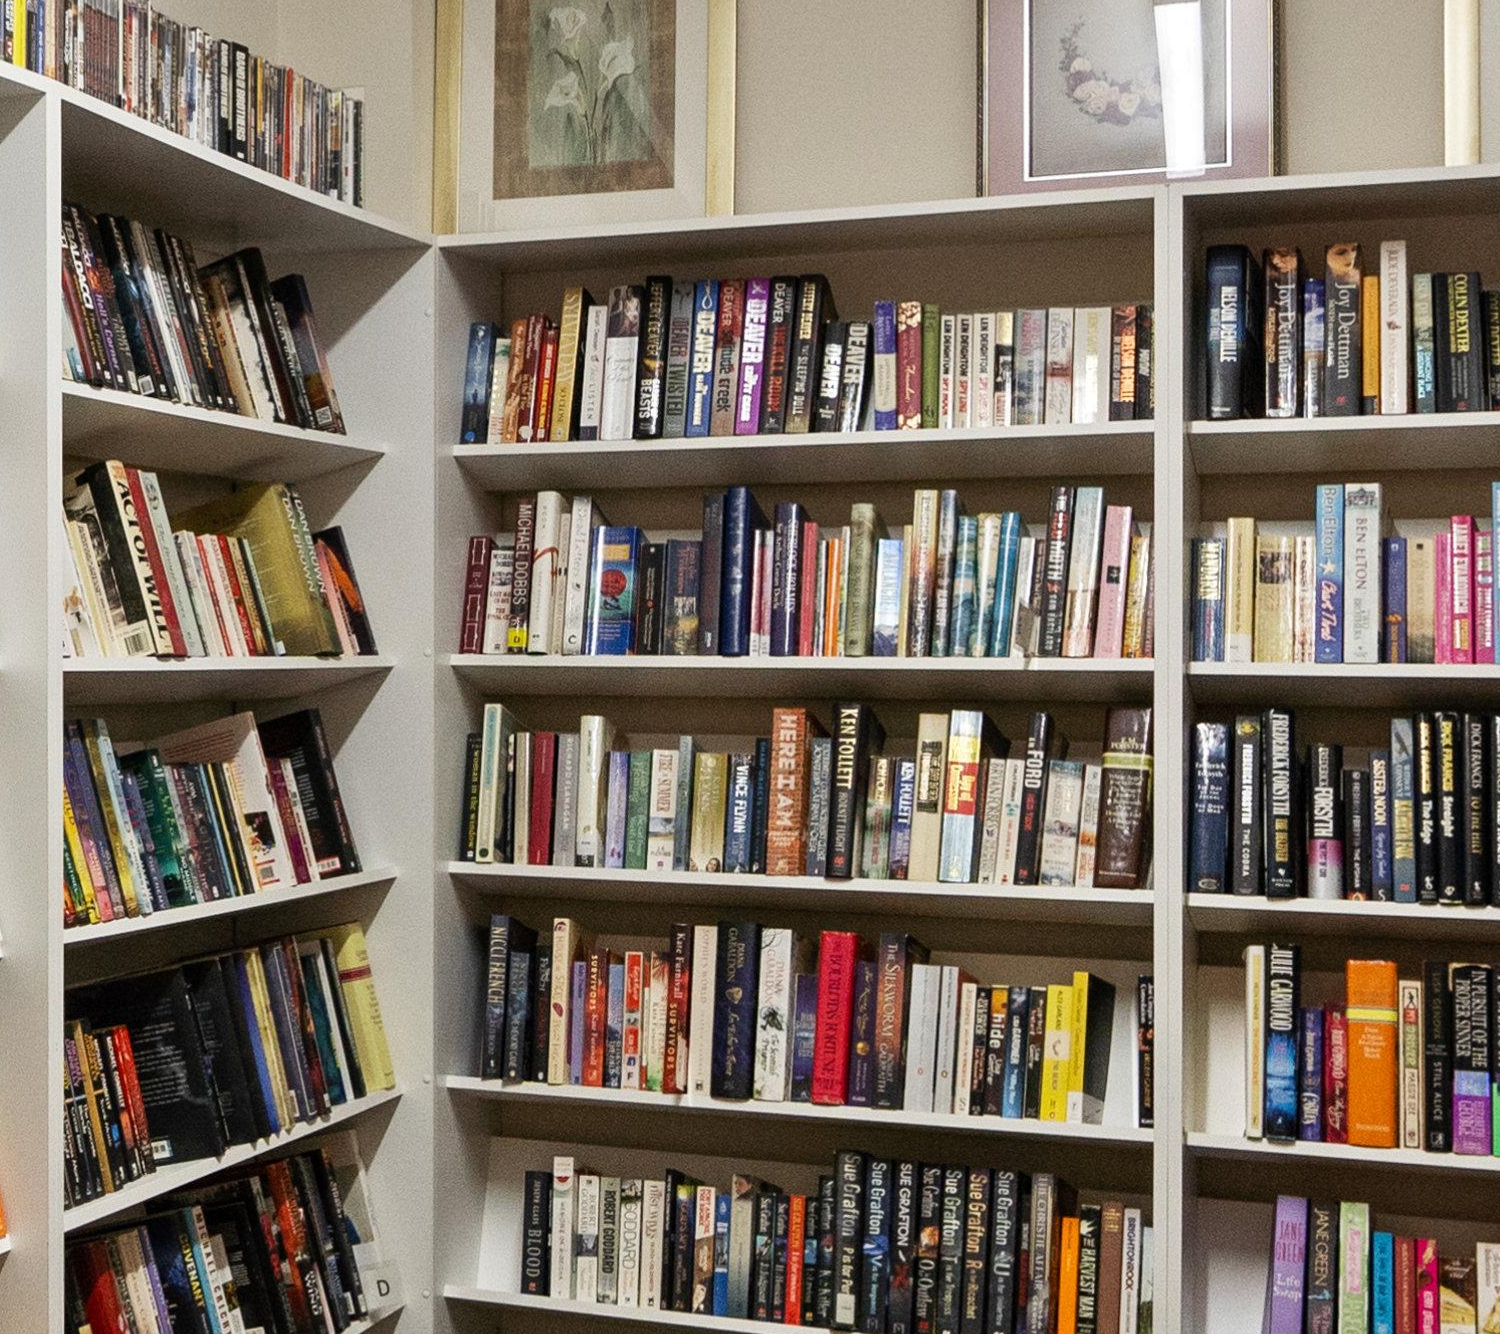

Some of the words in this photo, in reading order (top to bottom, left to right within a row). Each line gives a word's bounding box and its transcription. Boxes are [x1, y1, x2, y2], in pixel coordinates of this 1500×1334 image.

[1353, 517, 1369, 546] BEN
[1352, 548, 1368, 590] ELTON
[839, 708, 860, 735] KEN
[776, 714, 798, 771] HERE
[835, 737, 856, 790] FOLLETT
[734, 765, 751, 797] VINCE
[775, 774, 796, 790] I
[732, 799, 747, 833] FLYNN
[775, 794, 795, 828] AM
[1271, 943, 1293, 981] JULIE
[1270, 982, 1292, 1031] GARWOOD
[871, 1161, 887, 1189] Sue
[868, 1188, 886, 1235] Grafton
[375, 1277, 391, 1298] D
